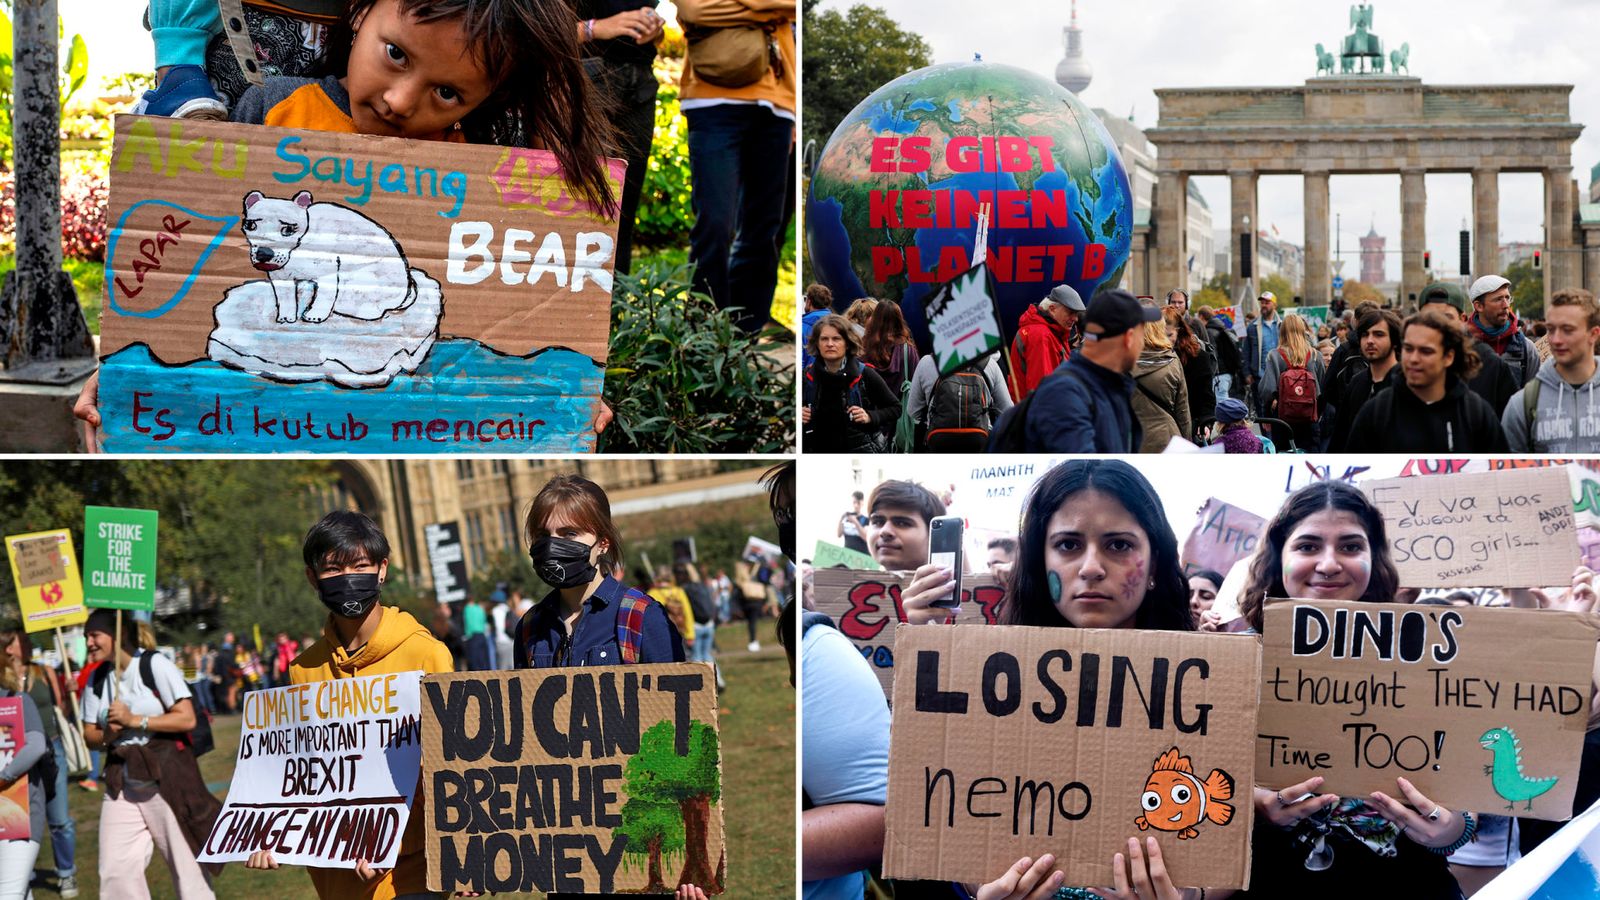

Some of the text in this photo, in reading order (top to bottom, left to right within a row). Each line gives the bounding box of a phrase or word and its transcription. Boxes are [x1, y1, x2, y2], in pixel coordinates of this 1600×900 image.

[272, 136, 467, 219] Sayang
[869, 136, 1056, 173] ES GIBT
[869, 190, 1067, 229] KEINEN
[115, 214, 193, 299] LAPAR
[445, 222, 613, 293] BEAR
[872, 244, 1105, 283] PLANET B
[132, 392, 545, 443] Es di kutub mencair
[971, 464, 1035, 480] ΠΛΑΝΗΤΗ
[986, 486, 1015, 498] ΜΑΣ
[99, 523, 143, 541] STRIKE
[108, 540, 132, 556] FOR
[92, 570, 146, 590] CLIMATE
[108, 555, 132, 572] THE
[1292, 605, 1463, 664] DINO'S
[244, 674, 400, 730] CLIMATE CHANGE
[916, 649, 1213, 736] LOSING
[1267, 666, 1583, 716] thought THEY HAD
[240, 713, 422, 760] IS MORE IMPORTANT THAN
[424, 672, 704, 763] YOU CAN'T
[1258, 723, 1446, 772] Time TOO!
[281, 754, 363, 797] BREXIT
[433, 764, 623, 834] BREATHE
[924, 766, 1092, 836] nemo
[206, 807, 399, 864] CHANGE MY MIND
[439, 833, 628, 893] MONEY
